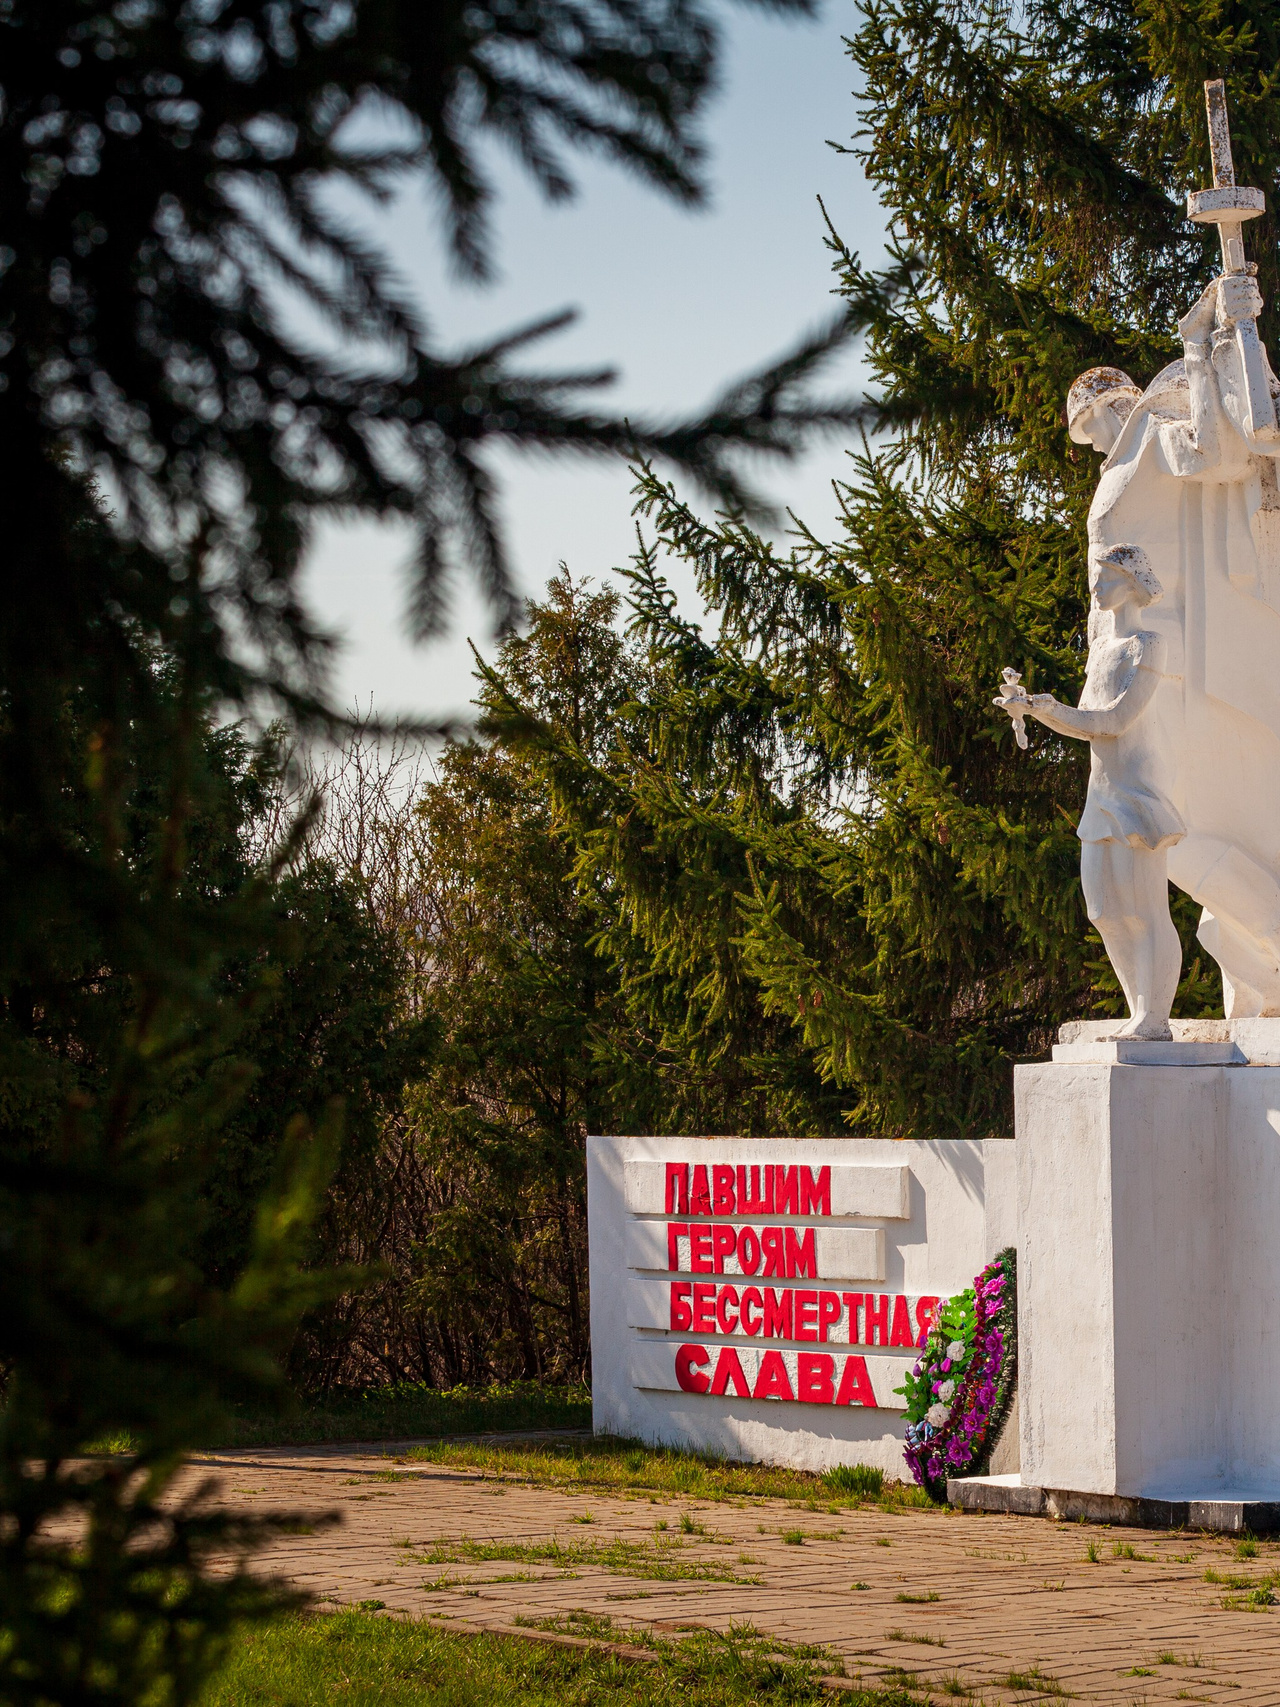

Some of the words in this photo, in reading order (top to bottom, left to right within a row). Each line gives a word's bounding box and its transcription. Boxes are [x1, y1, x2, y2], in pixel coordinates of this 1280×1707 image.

[665, 1162, 831, 1216] ПАВШИМ
[667, 1223, 817, 1279] ГЕРОЯМ
[670, 1282, 940, 1348] БЕССМЕРТНАЯ
[675, 1344, 878, 1408] СЛАВА
